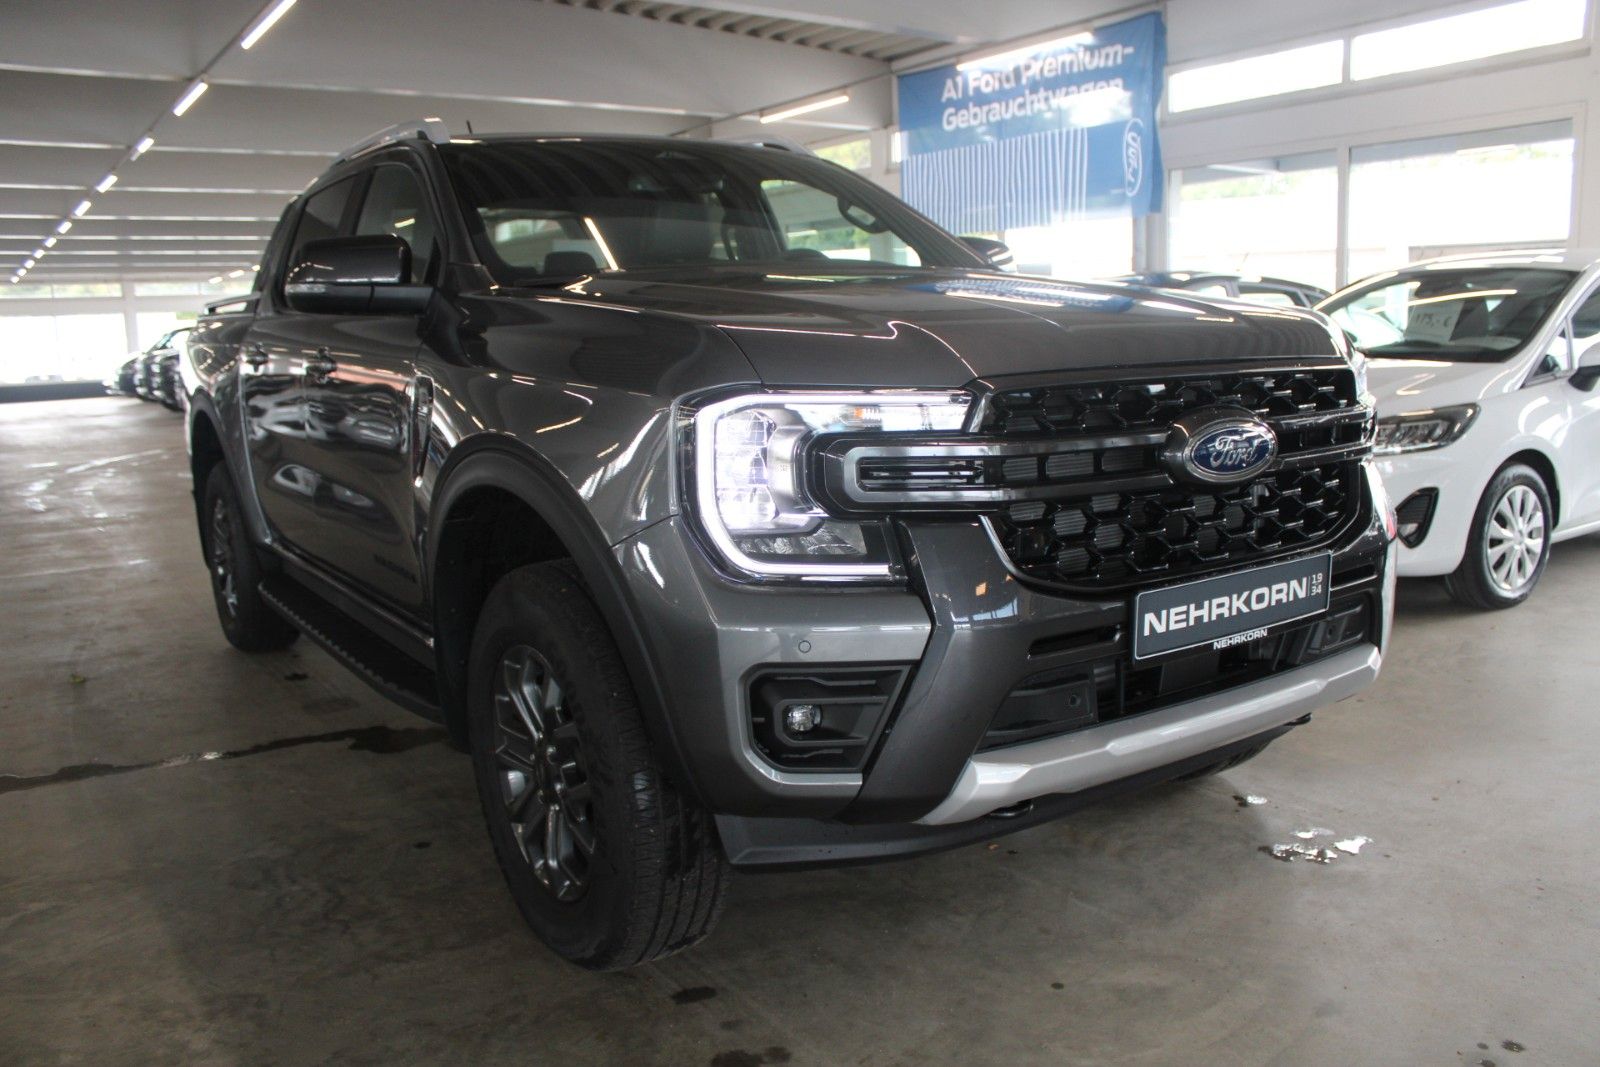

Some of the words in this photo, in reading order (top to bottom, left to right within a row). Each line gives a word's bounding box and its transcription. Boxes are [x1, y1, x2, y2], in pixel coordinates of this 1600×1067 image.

[967, 66, 1017, 97] Ford
[1021, 43, 1135, 85] Premium-
[1208, 433, 1264, 468] Ford
[1311, 572, 1323, 584] 19
[1311, 584, 1322, 596] 34
[1143, 576, 1308, 637] NEHRKORN
[1213, 628, 1268, 650] NEHRKORN
